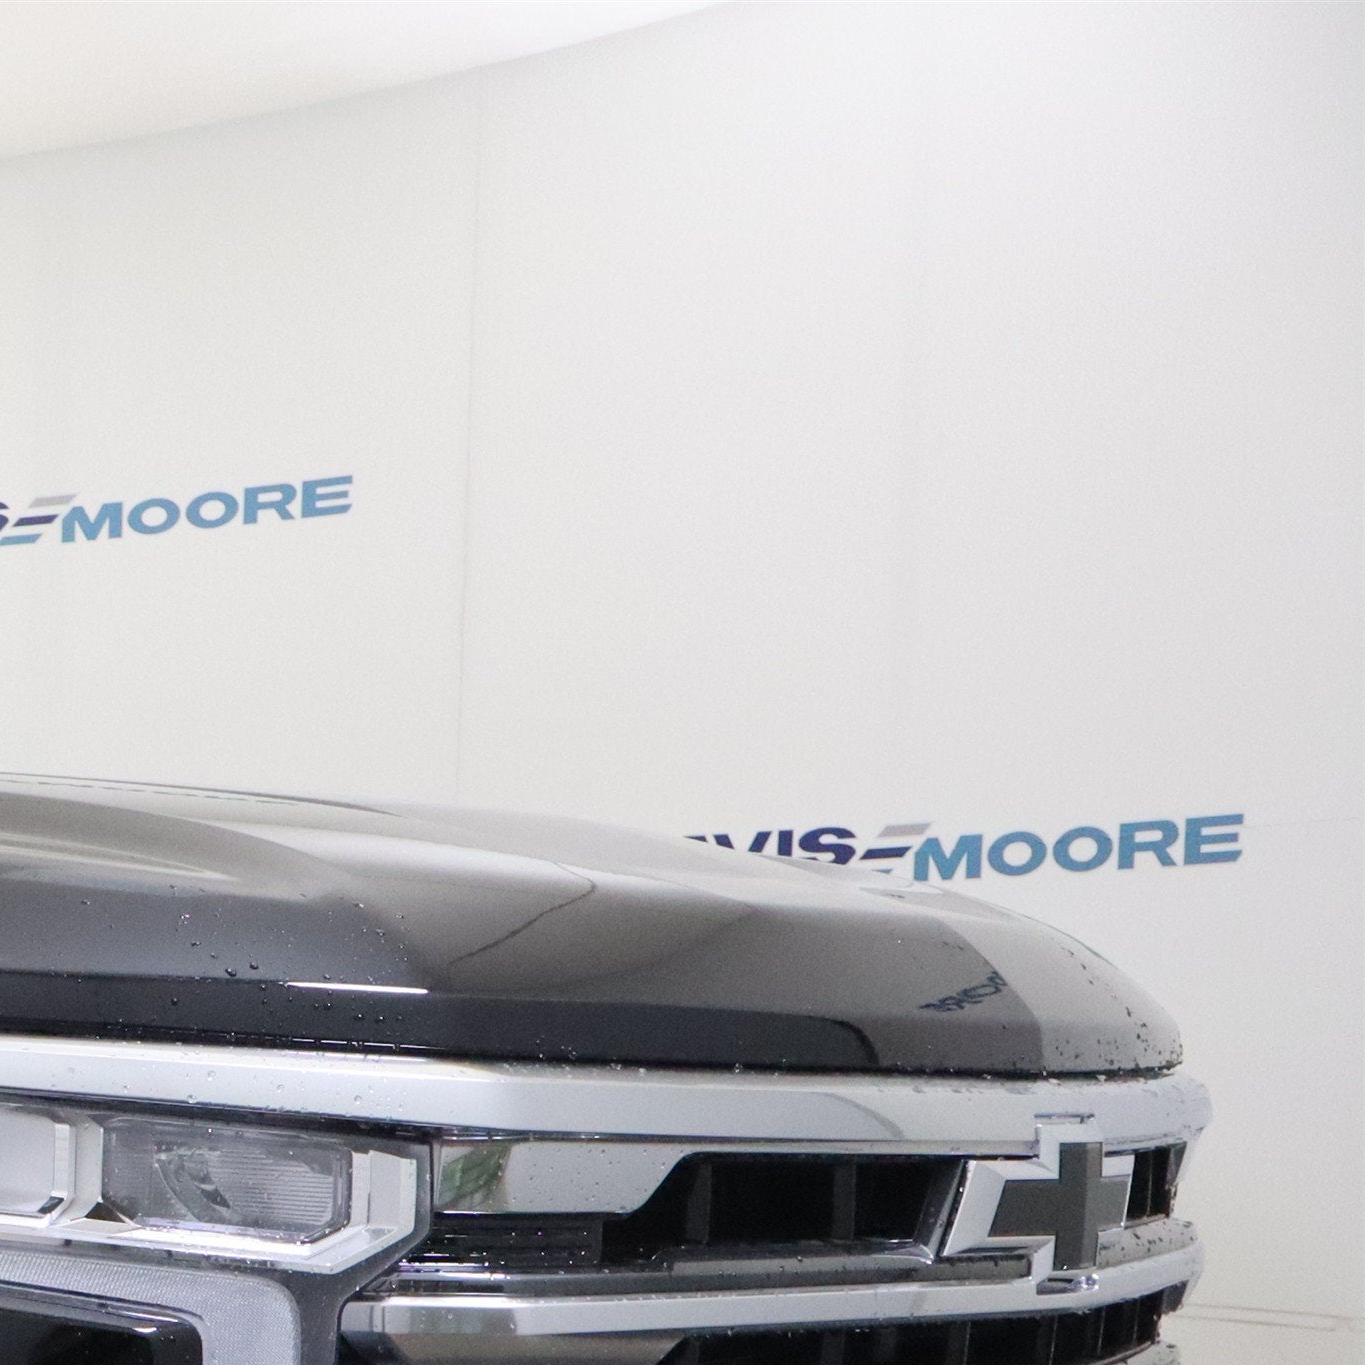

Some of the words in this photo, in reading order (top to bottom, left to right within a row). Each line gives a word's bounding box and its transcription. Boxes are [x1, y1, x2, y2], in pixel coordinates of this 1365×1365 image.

[60, 475, 353, 543] MOORE
[683, 827, 857, 864] VIS
[913, 813, 1244, 882] MOORE
